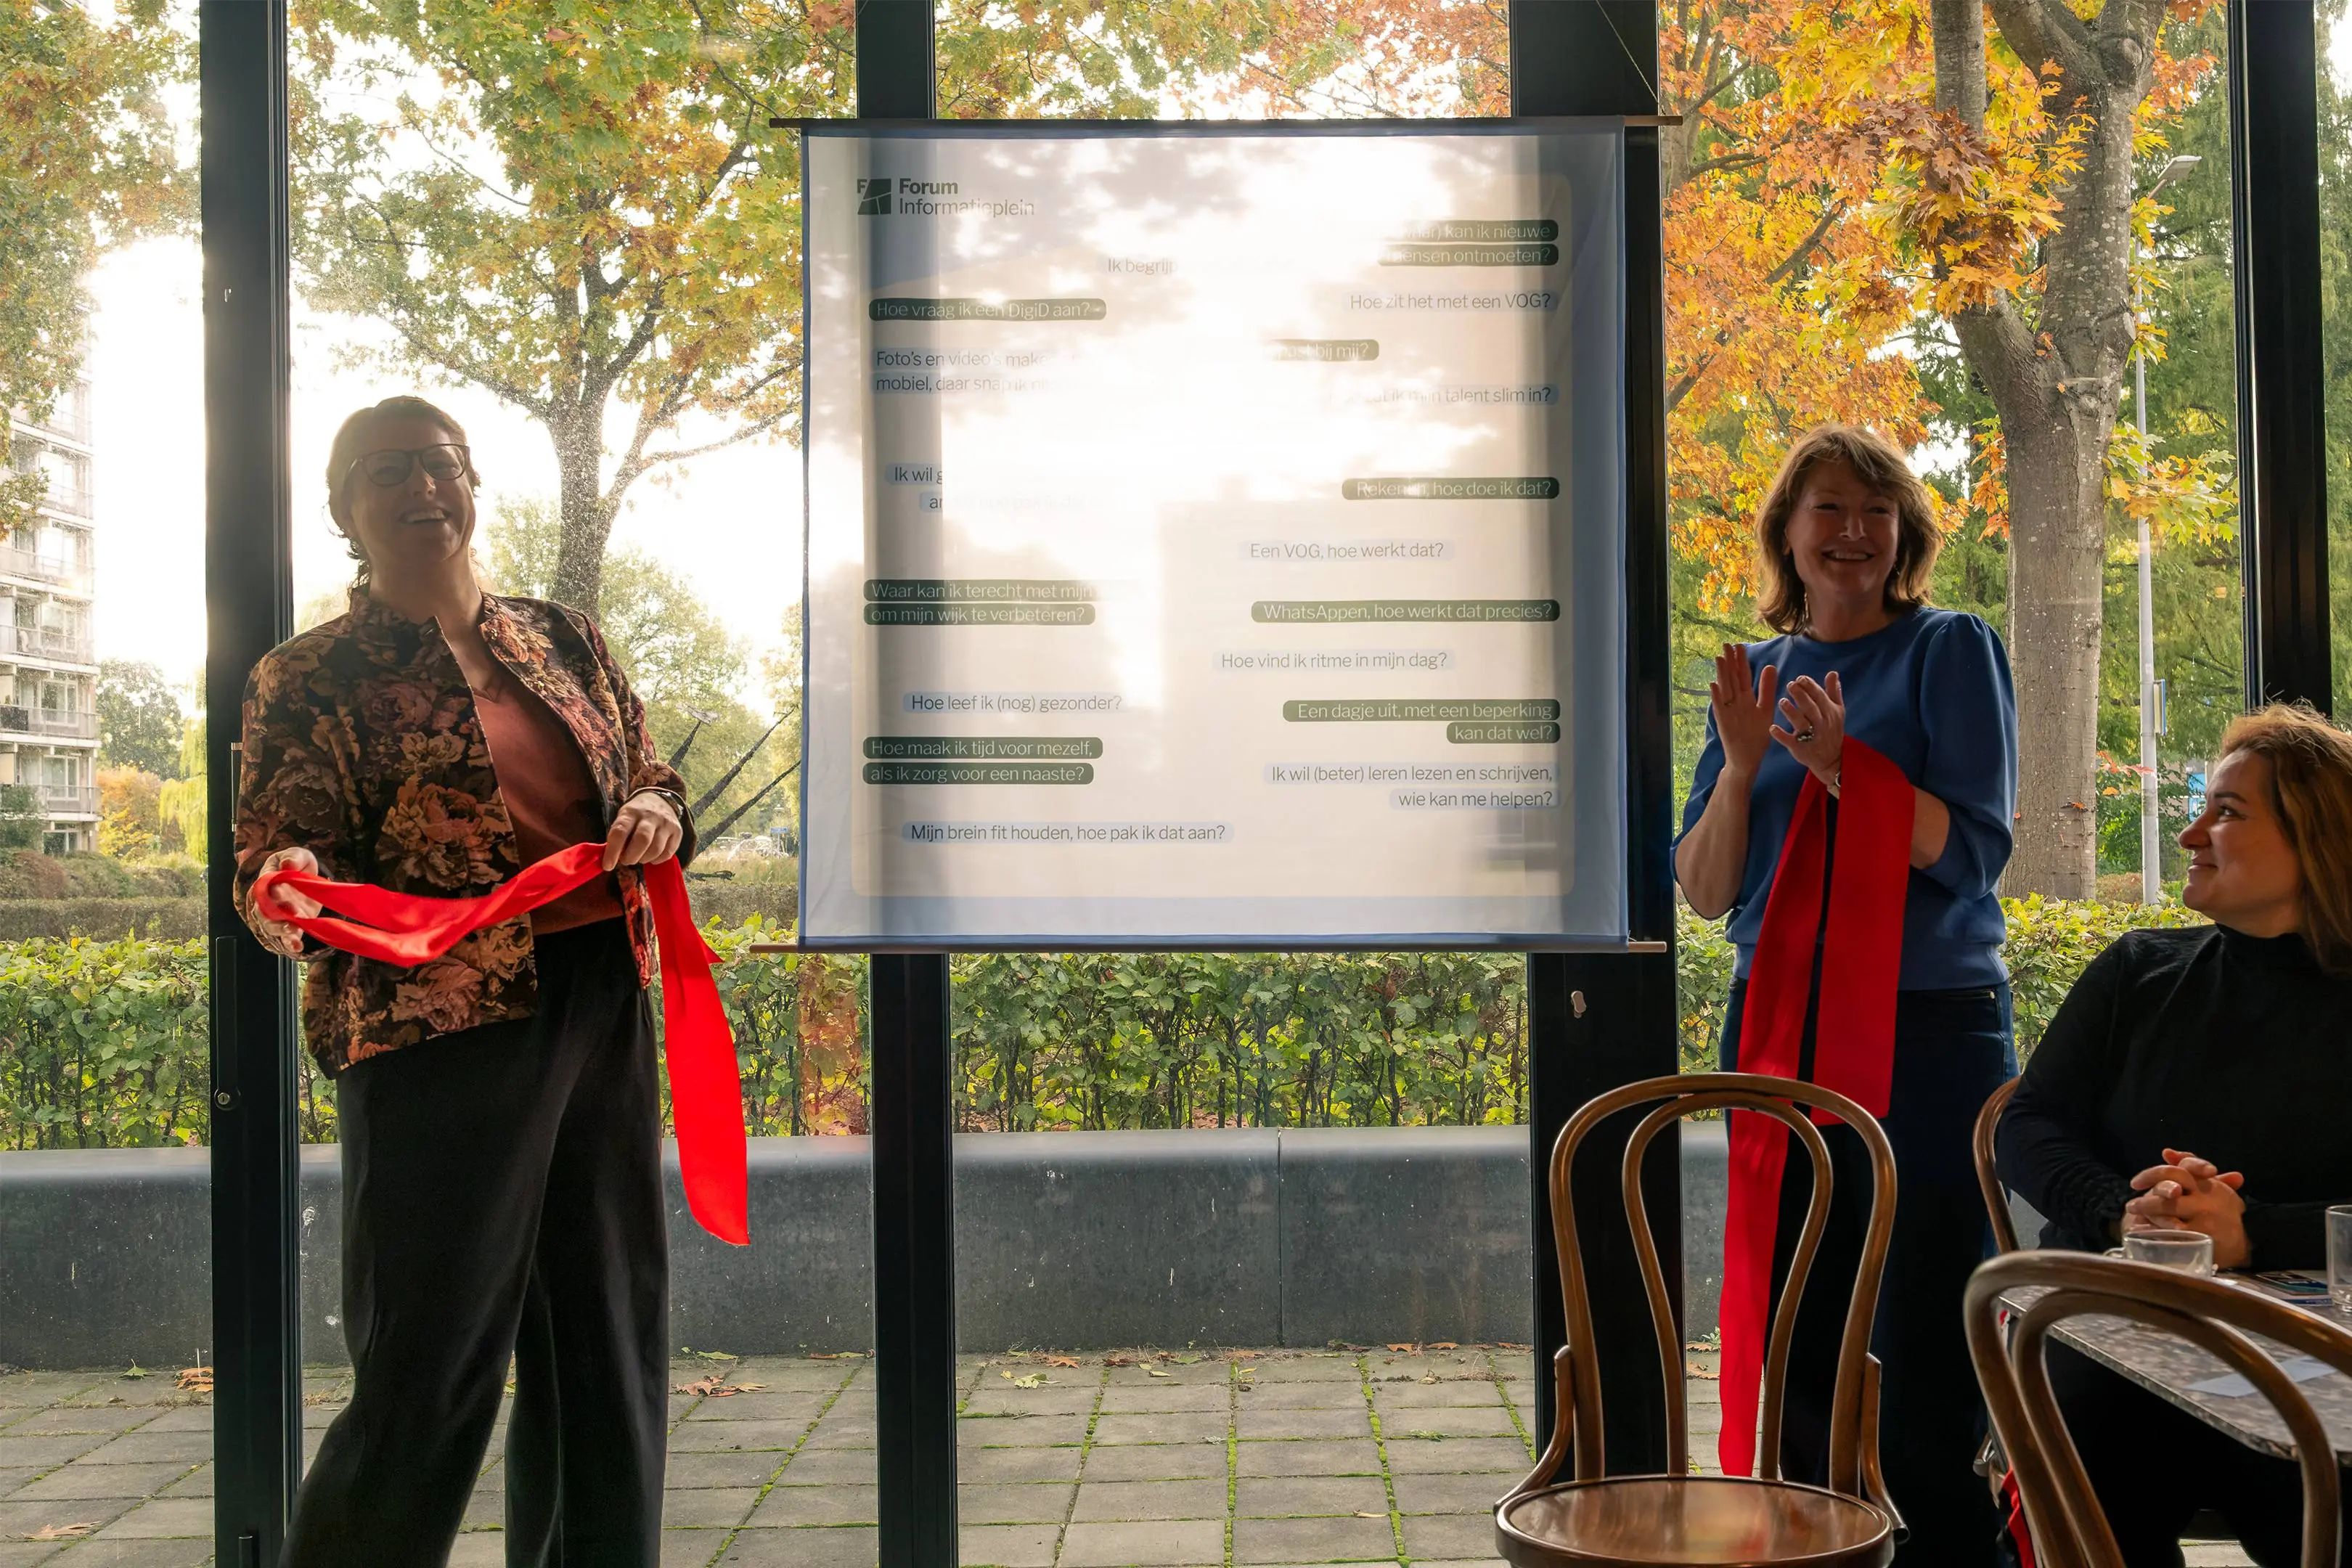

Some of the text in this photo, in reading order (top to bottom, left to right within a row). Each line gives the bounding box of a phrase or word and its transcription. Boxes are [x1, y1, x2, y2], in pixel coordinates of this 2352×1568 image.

[899, 179, 957, 195] Forum
[899, 197, 1034, 218] Informatieplein
[1445, 224, 1473, 238] kan
[1477, 224, 1489, 238] ik
[1494, 224, 1551, 238] nieuwe
[1454, 248, 1551, 263] ontmoeten?
[1108, 258, 1122, 272] Ik
[1350, 293, 1551, 309] Hoe zit het met een VOG?
[876, 302, 1090, 319] Hoe vraag ik een DigiD aan?
[876, 351, 921, 367] Foto's
[926, 354, 944, 367] en
[1005, 351, 1052, 367] make
[1315, 343, 1332, 361] bij
[1336, 342, 1369, 361] mij?
[876, 377, 932, 393] mobiel,
[936, 377, 969, 391] daar
[974, 379, 1010, 395] snap
[1446, 388, 1489, 402] talent
[1493, 388, 1524, 402] slim
[1528, 387, 1551, 402] in?
[894, 467, 908, 481] Ik
[912, 467, 932, 481] wil
[1433, 481, 1463, 496] hoe
[1466, 481, 1496, 496] doe
[1500, 481, 1513, 495] ik
[1516, 481, 1551, 495] dat?
[1251, 542, 1444, 560] Een VOG, hoe werkt dat?
[872, 584, 913, 597] Waar
[918, 584, 944, 597] kan
[949, 583, 962, 597] ik
[965, 583, 1021, 597] terecht
[1026, 584, 1057, 597] met
[1061, 584, 1093, 601] mijn
[872, 607, 1085, 624] om mijn wijk te verbeteren?
[1264, 603, 1552, 621] WhatsAppen, hoe werkt dat precies?
[1222, 653, 1447, 669] Hoe vind ik ritme in mijn dag?
[912, 695, 1122, 713] Hoe leef ik (nog) gezonder?
[1299, 703, 1552, 720] Een dagje uit, met een beperking
[1455, 726, 1552, 740] kan dat wel?
[872, 740, 1093, 757] Hoe maak ik tijd voor mezelf,
[871, 767, 1085, 783] als ik zorg voor een naaste?
[1272, 766, 1553, 783] Ik wil (beter) leren lezen en schrijven,
[1399, 791, 1553, 809] wie kan me helpen?
[911, 825, 1226, 843] Mijn brein fit houden, hoe pak ik dat aan?
